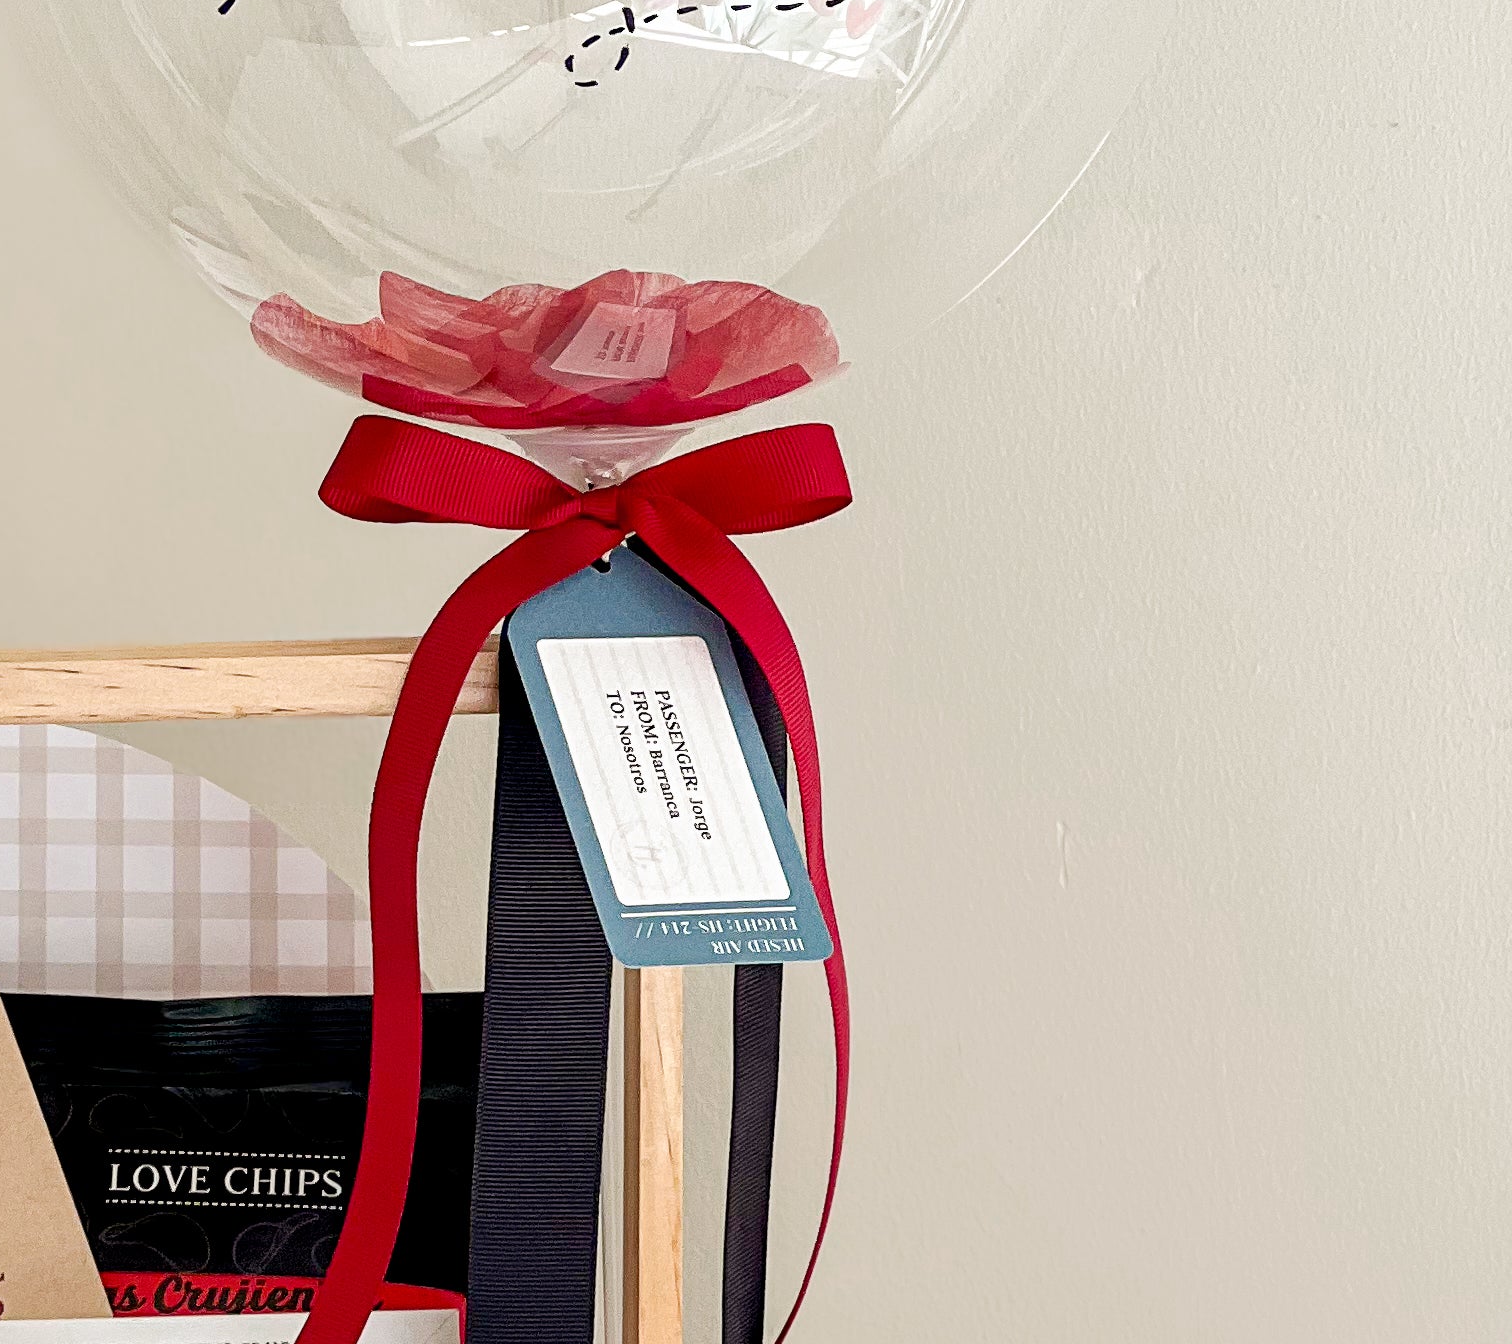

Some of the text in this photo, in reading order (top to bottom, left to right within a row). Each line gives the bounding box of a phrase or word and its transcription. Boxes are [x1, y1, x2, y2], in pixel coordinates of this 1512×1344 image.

[606, 690, 647, 794] TO: Nosotros
[630, 690, 680, 819] FROM: Barranca
[654, 690, 712, 840] PASSENGER: Jorge
[710, 938, 805, 954] HESED AIR
[108, 1162, 342, 1198] LOVE CHIPS
[152, 1275, 316, 1314] Crujien
